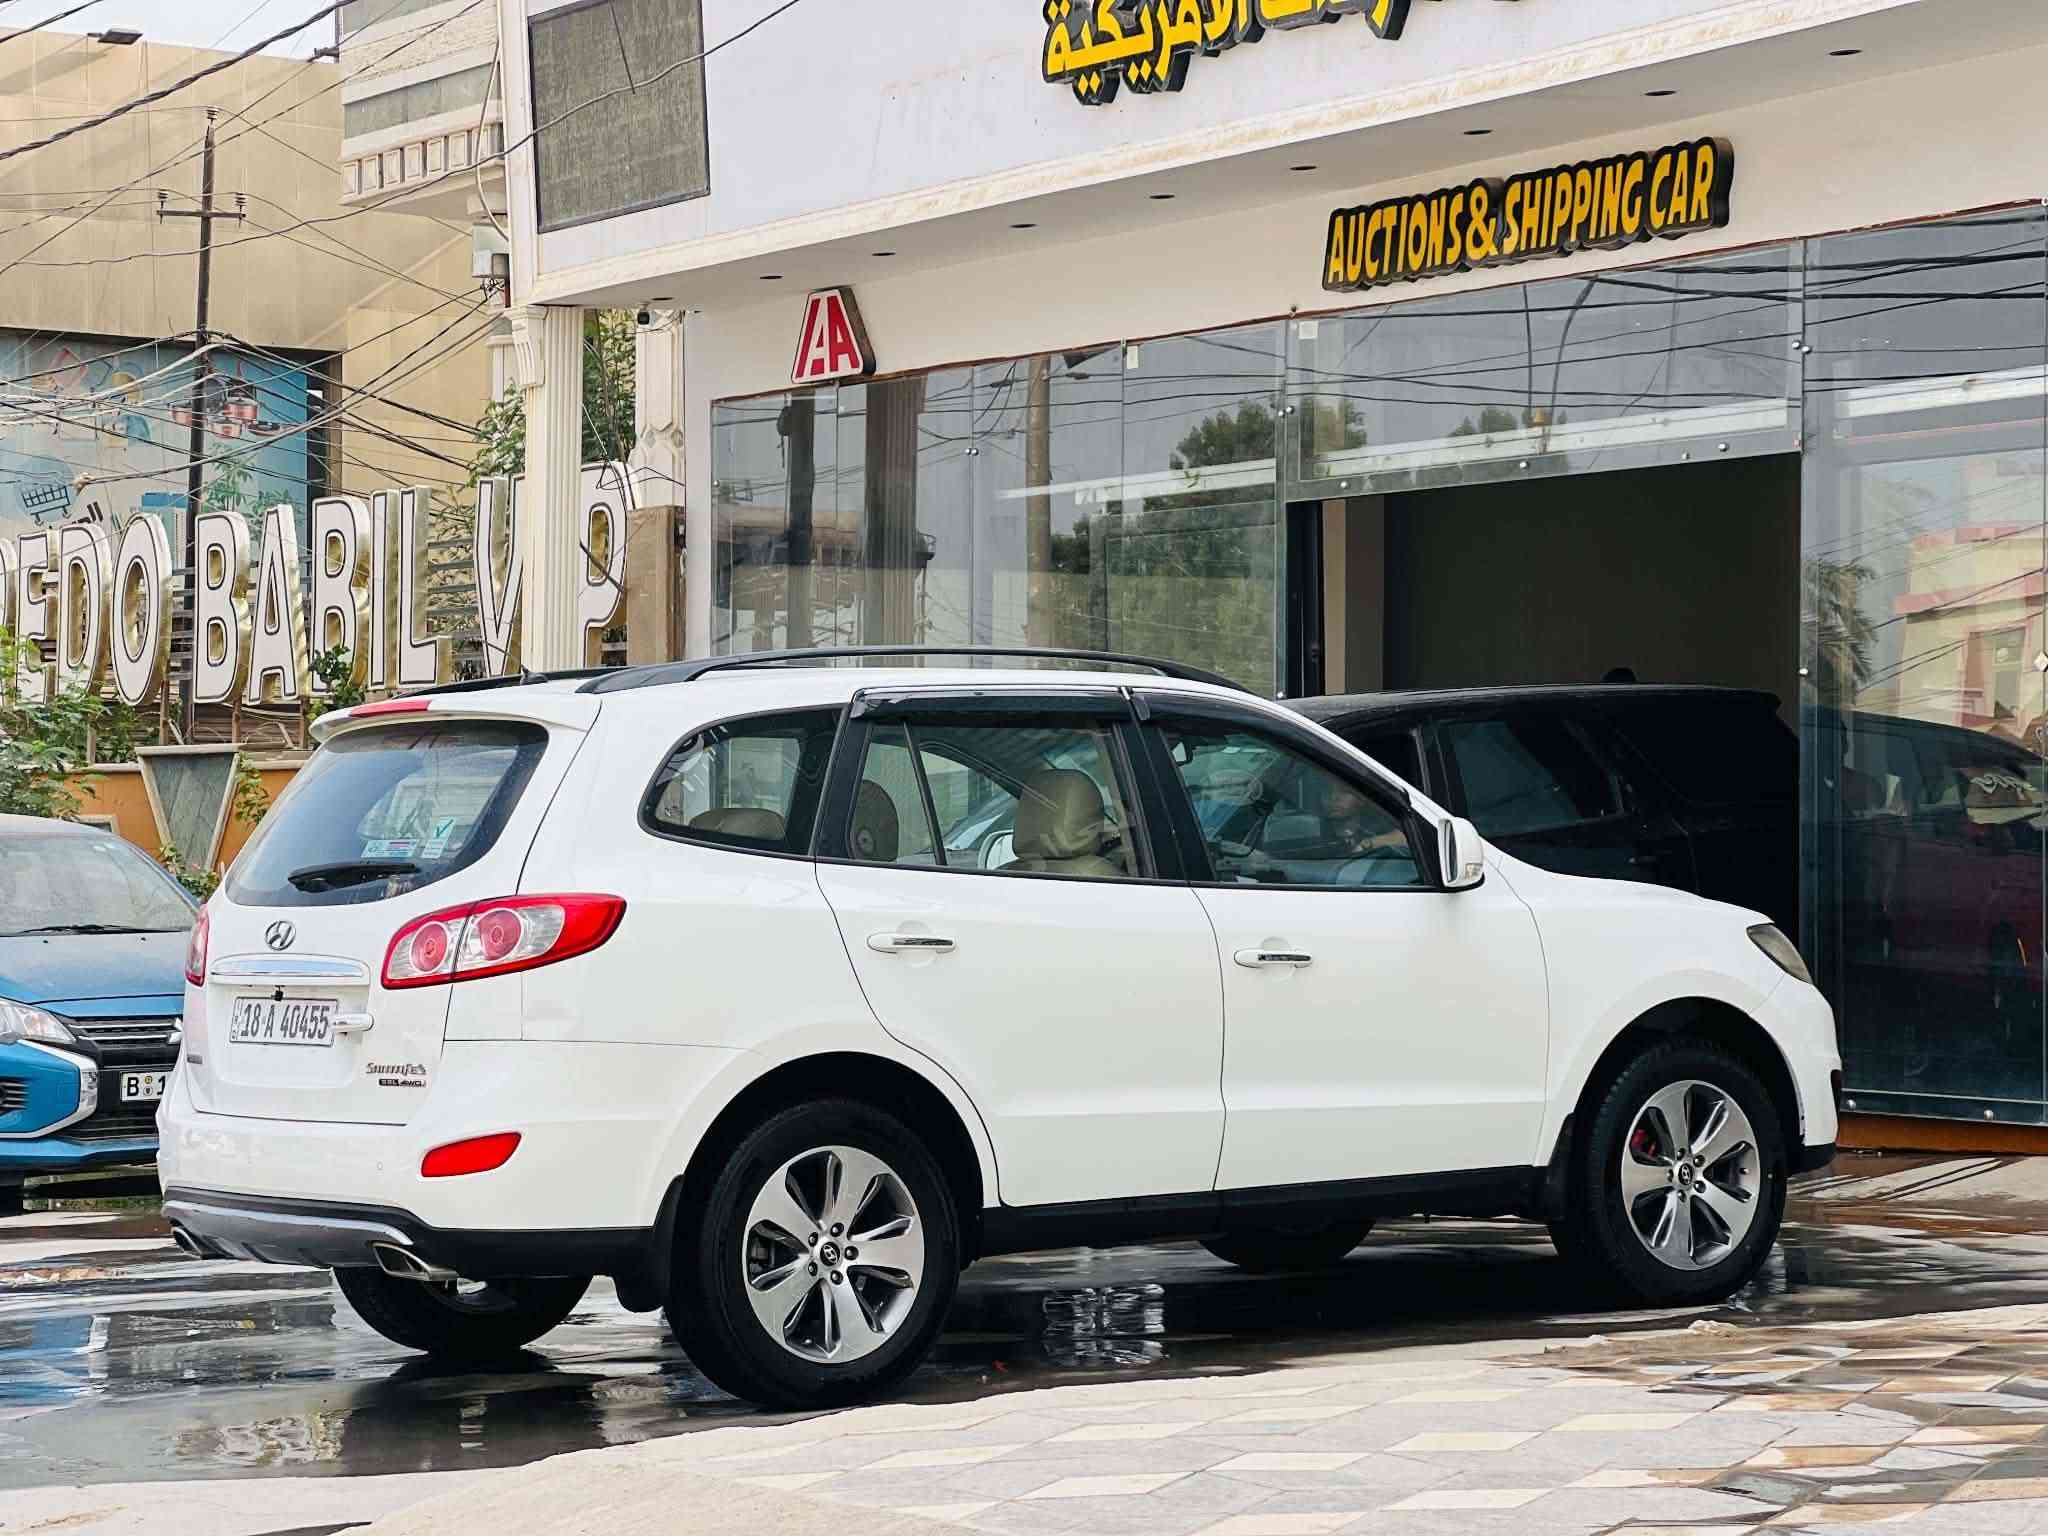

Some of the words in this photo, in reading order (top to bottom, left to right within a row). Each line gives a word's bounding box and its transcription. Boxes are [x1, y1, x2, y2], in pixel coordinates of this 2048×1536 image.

[1326, 192, 1464, 284] AUCTIONS
[1502, 158, 1645, 256] SHIPPING
[1649, 144, 1715, 229] CAR
[0, 512, 164, 706] EDO
[193, 486, 446, 702] BABIL
[472, 462, 633, 678] VP
[240, 1003, 261, 1037] 18
[280, 1004, 330, 1039] 40455
[127, 1077, 139, 1096] B
